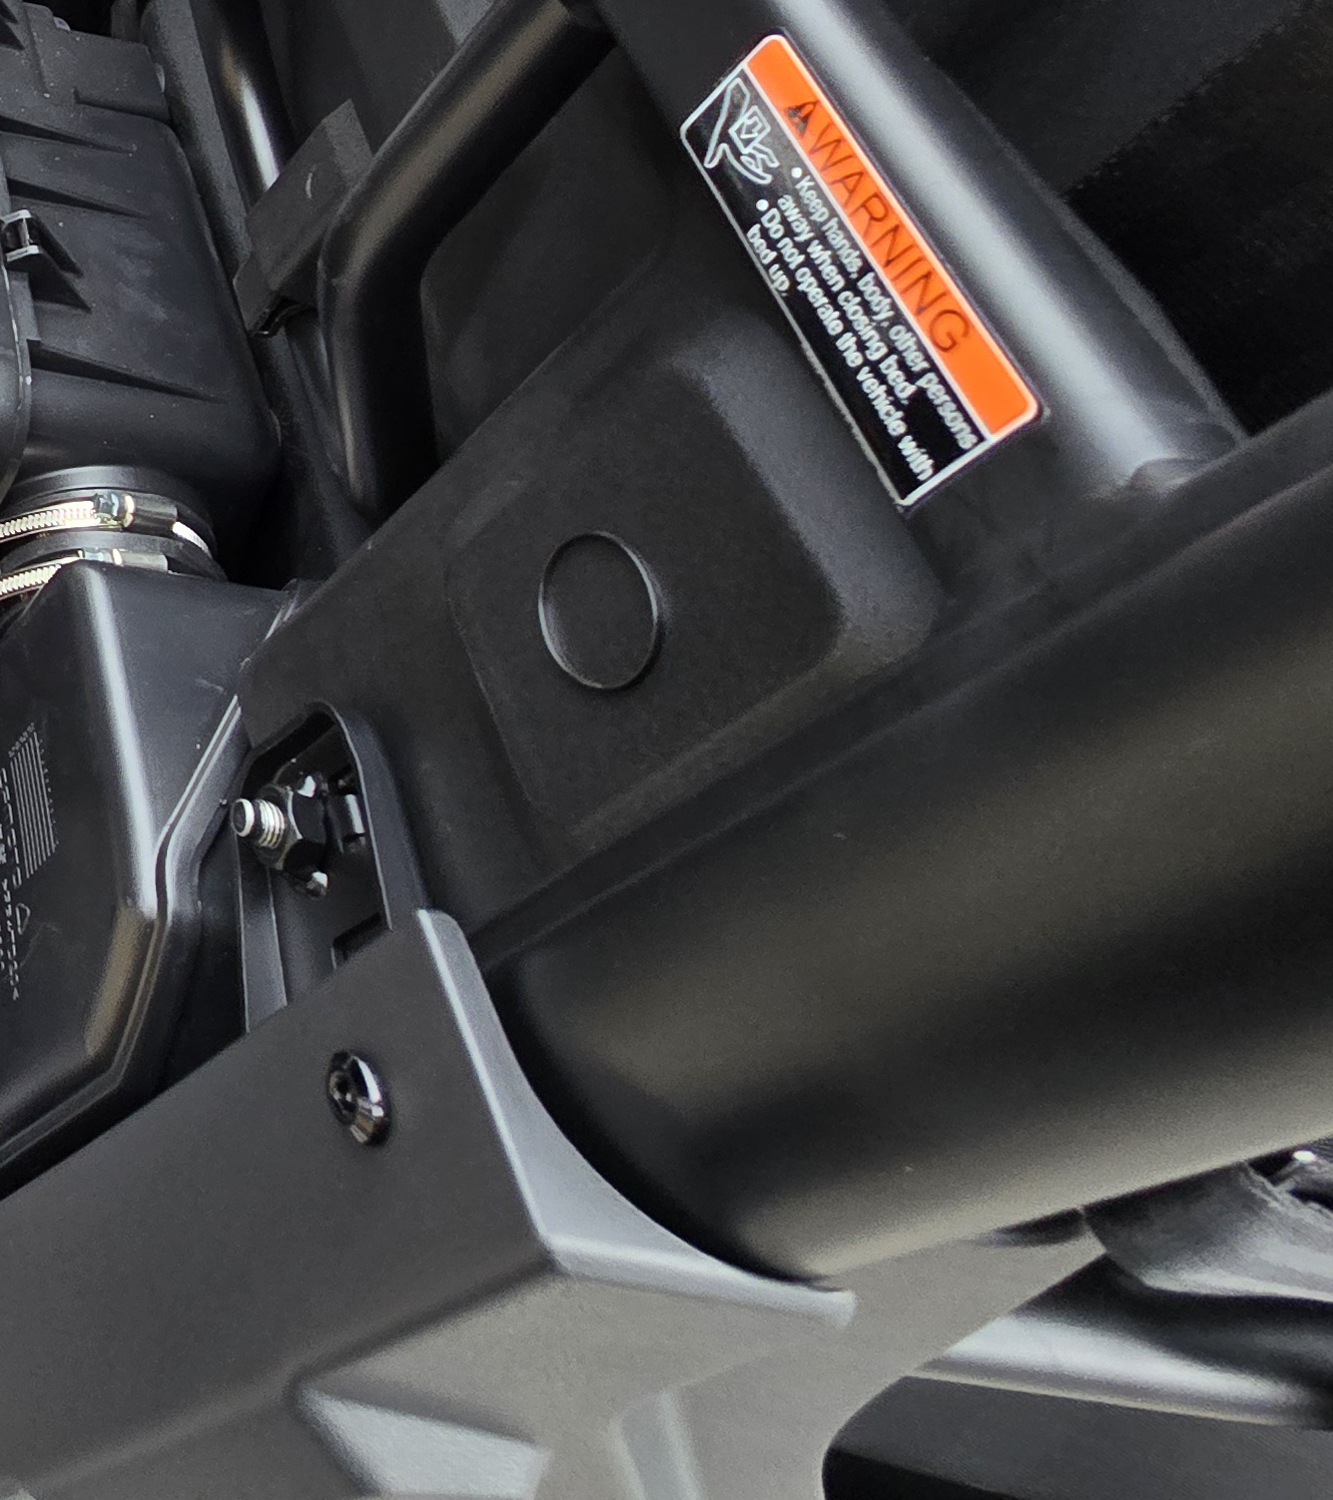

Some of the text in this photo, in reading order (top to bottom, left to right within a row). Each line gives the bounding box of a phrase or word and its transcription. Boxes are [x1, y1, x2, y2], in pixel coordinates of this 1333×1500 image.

[747, 224, 791, 297] bed up.
[761, 208, 934, 480] Do not operate the vehicle with
[777, 194, 917, 405] away when closing bed.
[795, 175, 978, 450] Keep hands, body, other persons
[809, 123, 970, 352] WARNING
